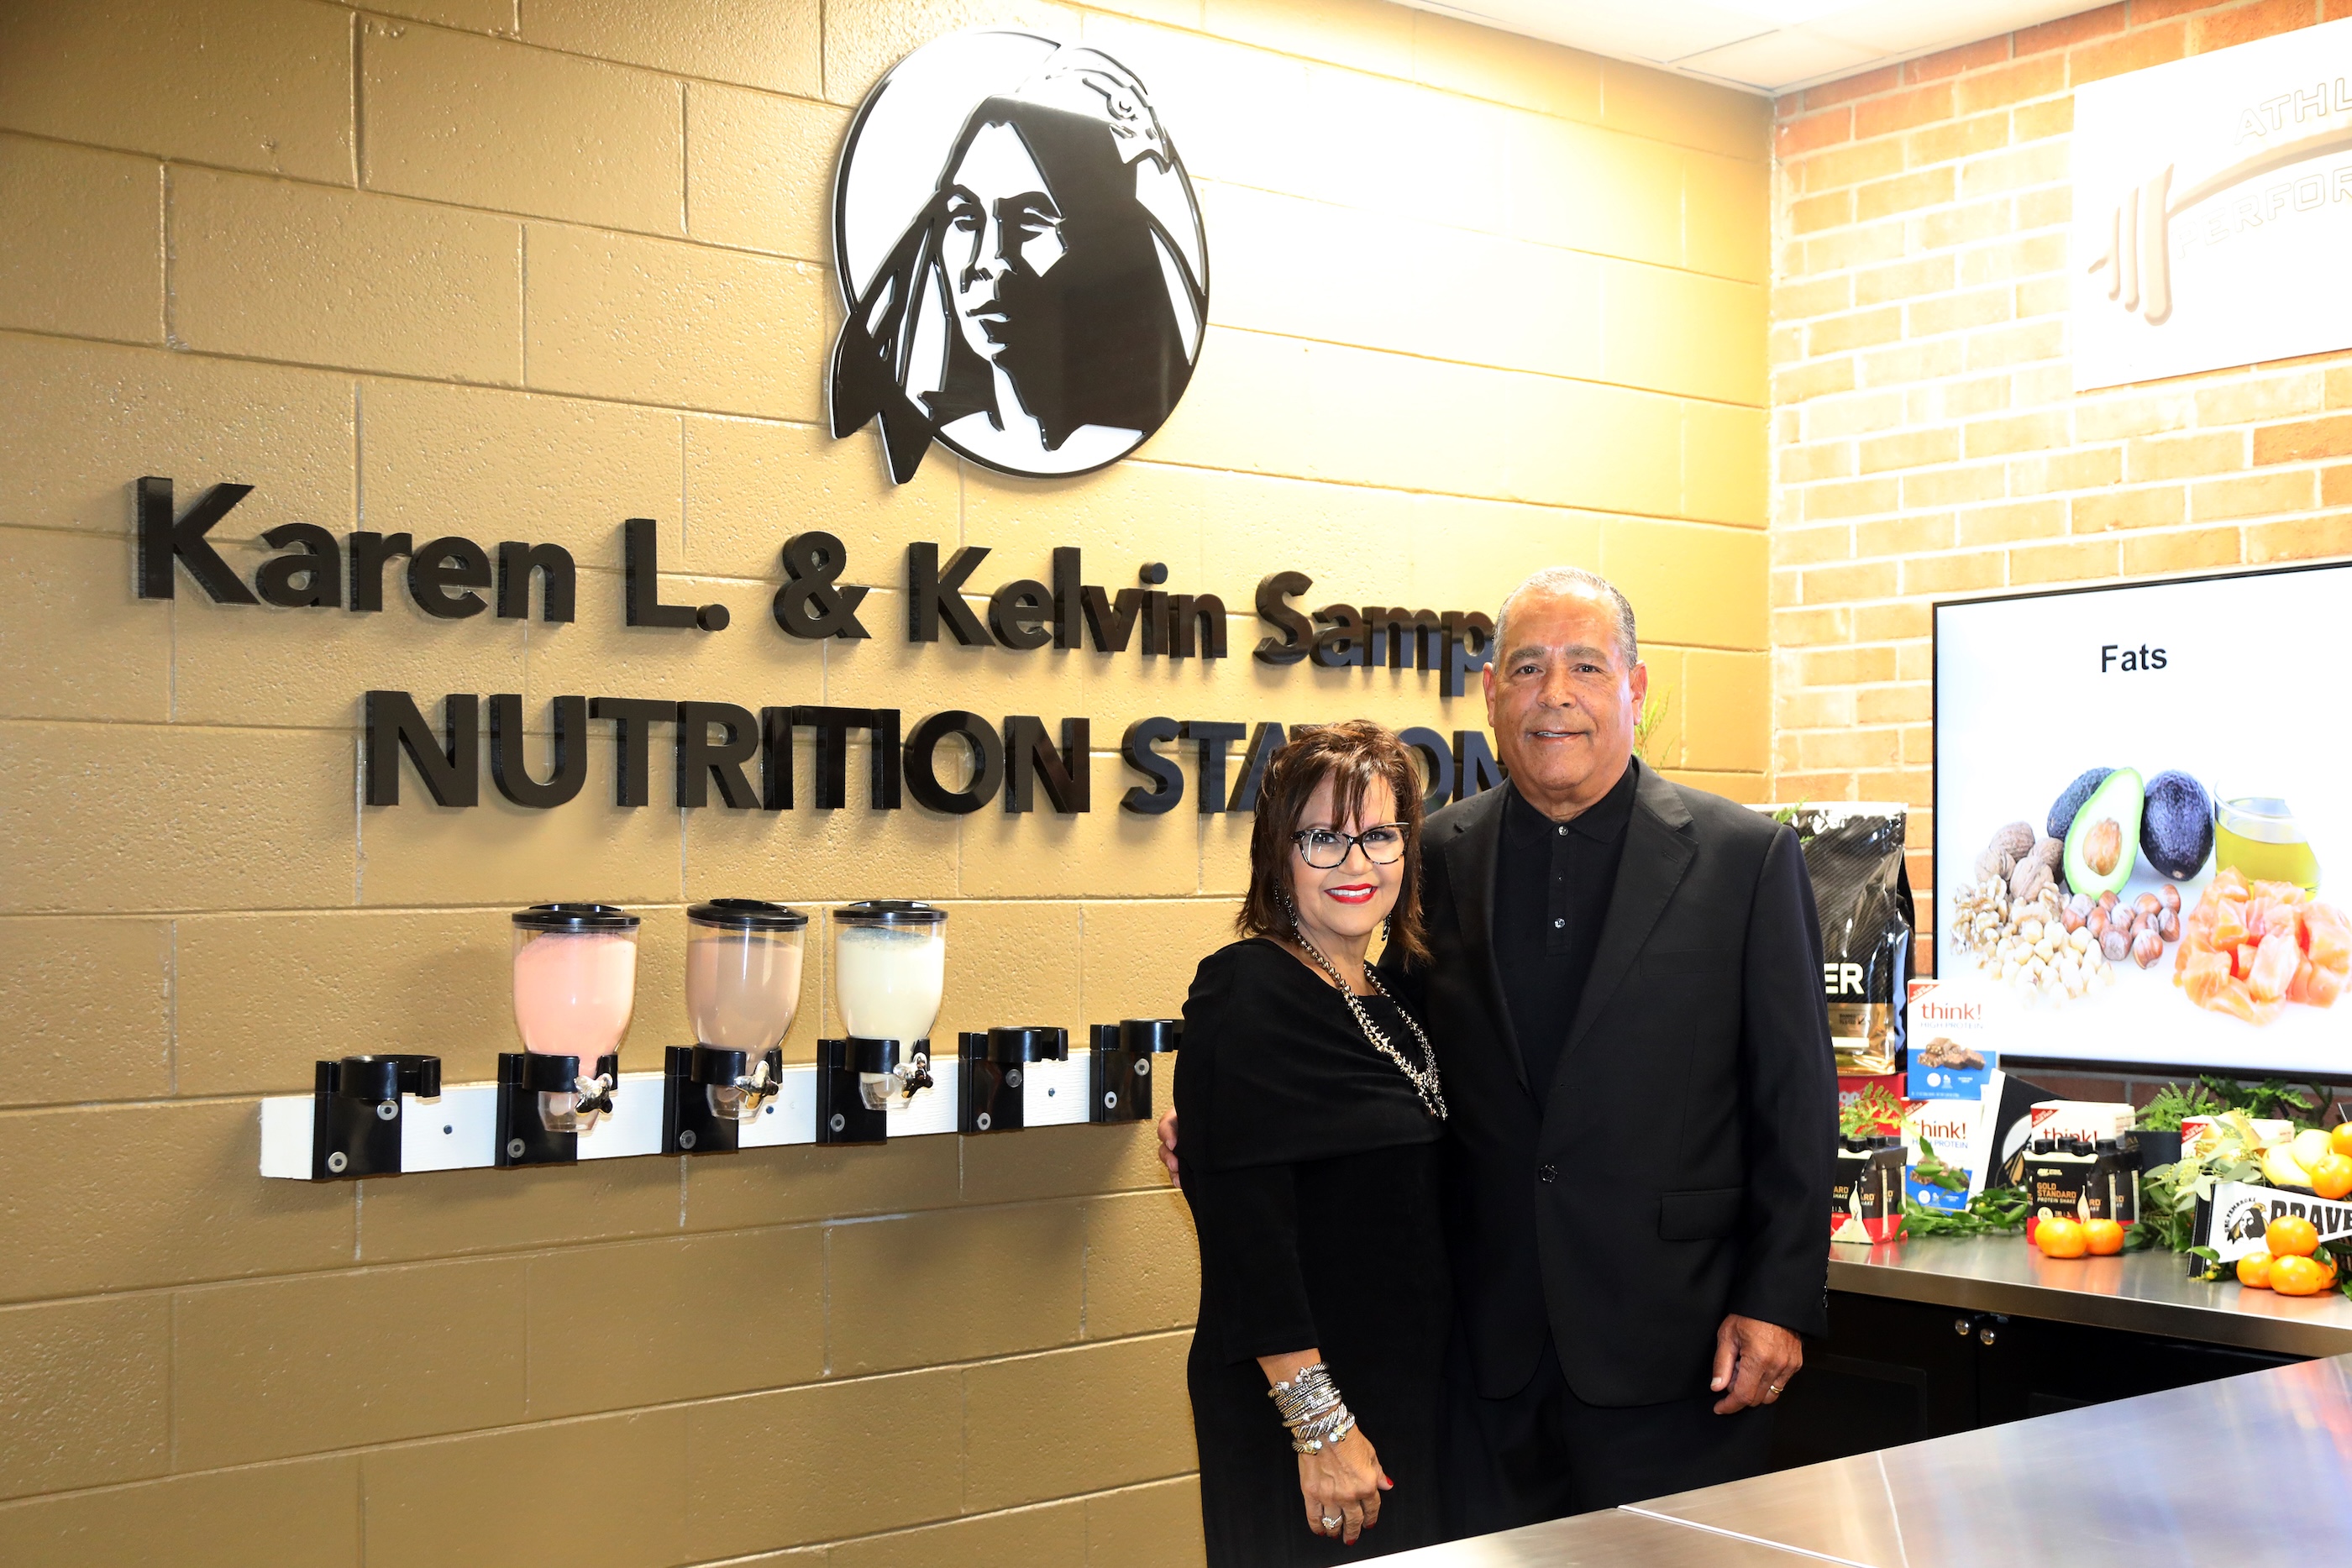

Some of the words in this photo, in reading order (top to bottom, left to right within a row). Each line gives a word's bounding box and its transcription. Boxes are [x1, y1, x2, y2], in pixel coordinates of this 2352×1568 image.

[137, 476, 576, 623] Karen
[624, 518, 731, 632] L.
[774, 531, 869, 640] &
[909, 541, 1227, 659] Kelvin
[2102, 643, 2167, 673] Fats
[365, 690, 1090, 815] NUTRITION
[1121, 716, 1510, 815] STAON
[1921, 1002, 1982, 1020] think!
[1934, 1139, 1968, 1149] PROTEIN
[2036, 1182, 2057, 1190] GOLD
[2036, 1189, 2077, 1199] STANDARD
